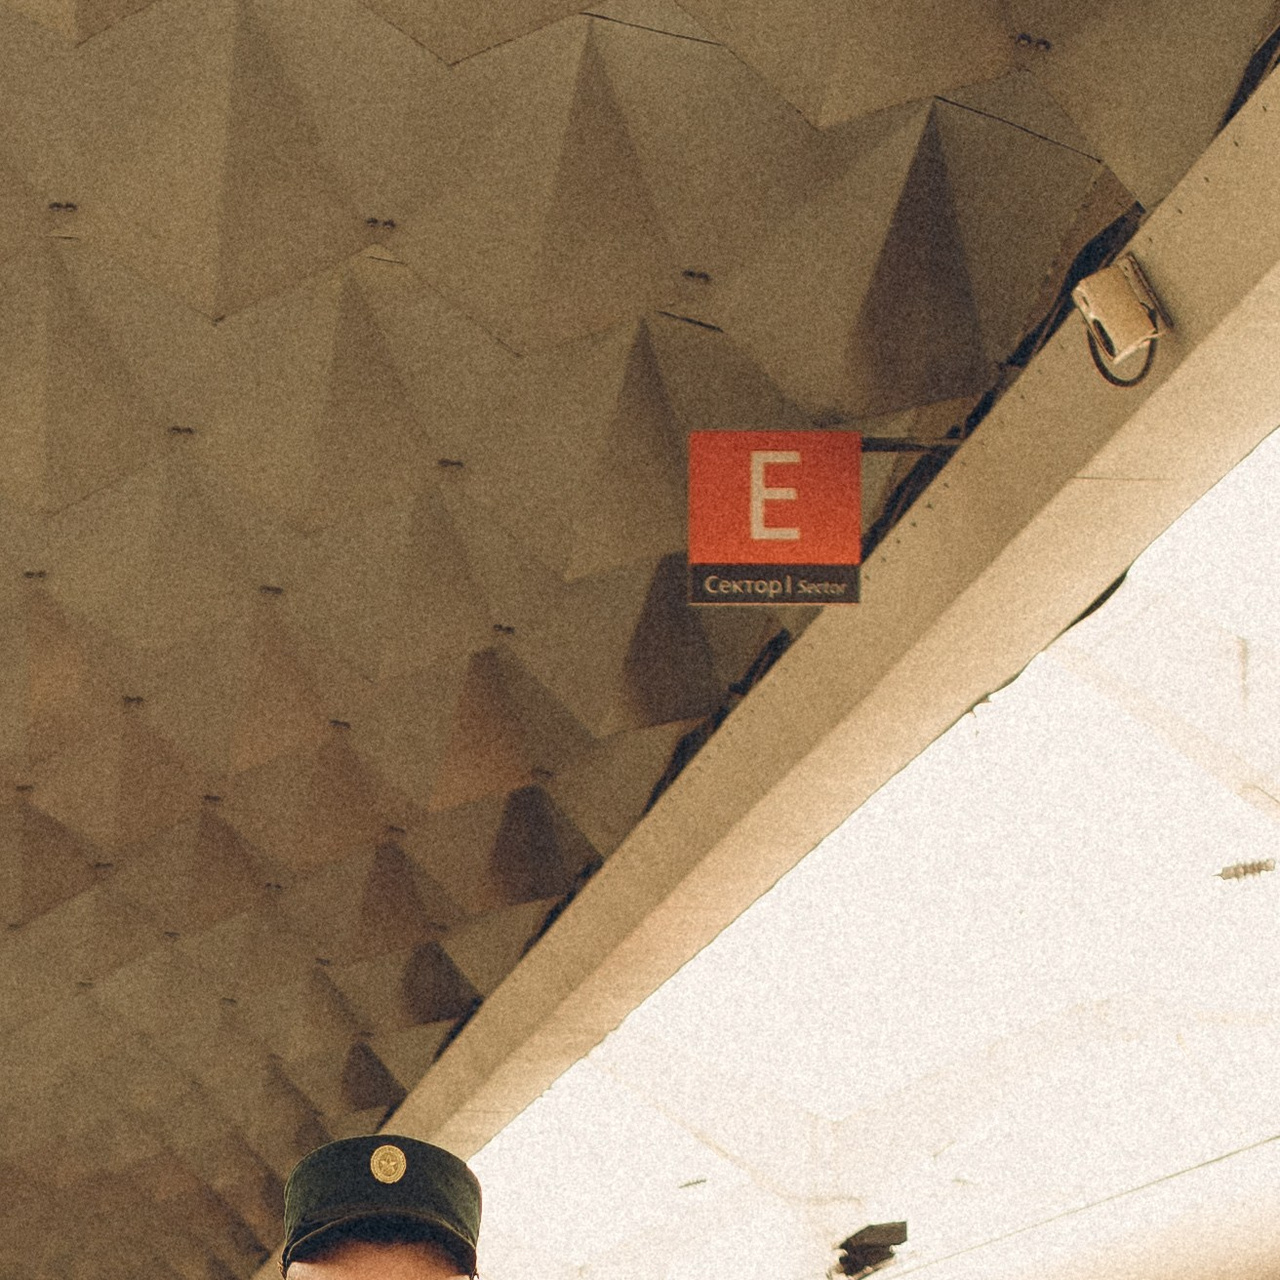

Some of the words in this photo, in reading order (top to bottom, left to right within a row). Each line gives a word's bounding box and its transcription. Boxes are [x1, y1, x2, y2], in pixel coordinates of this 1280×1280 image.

[750, 451, 801, 540] E
[704, 575, 783, 598] Сектор
[797, 579, 848, 594] Sector
